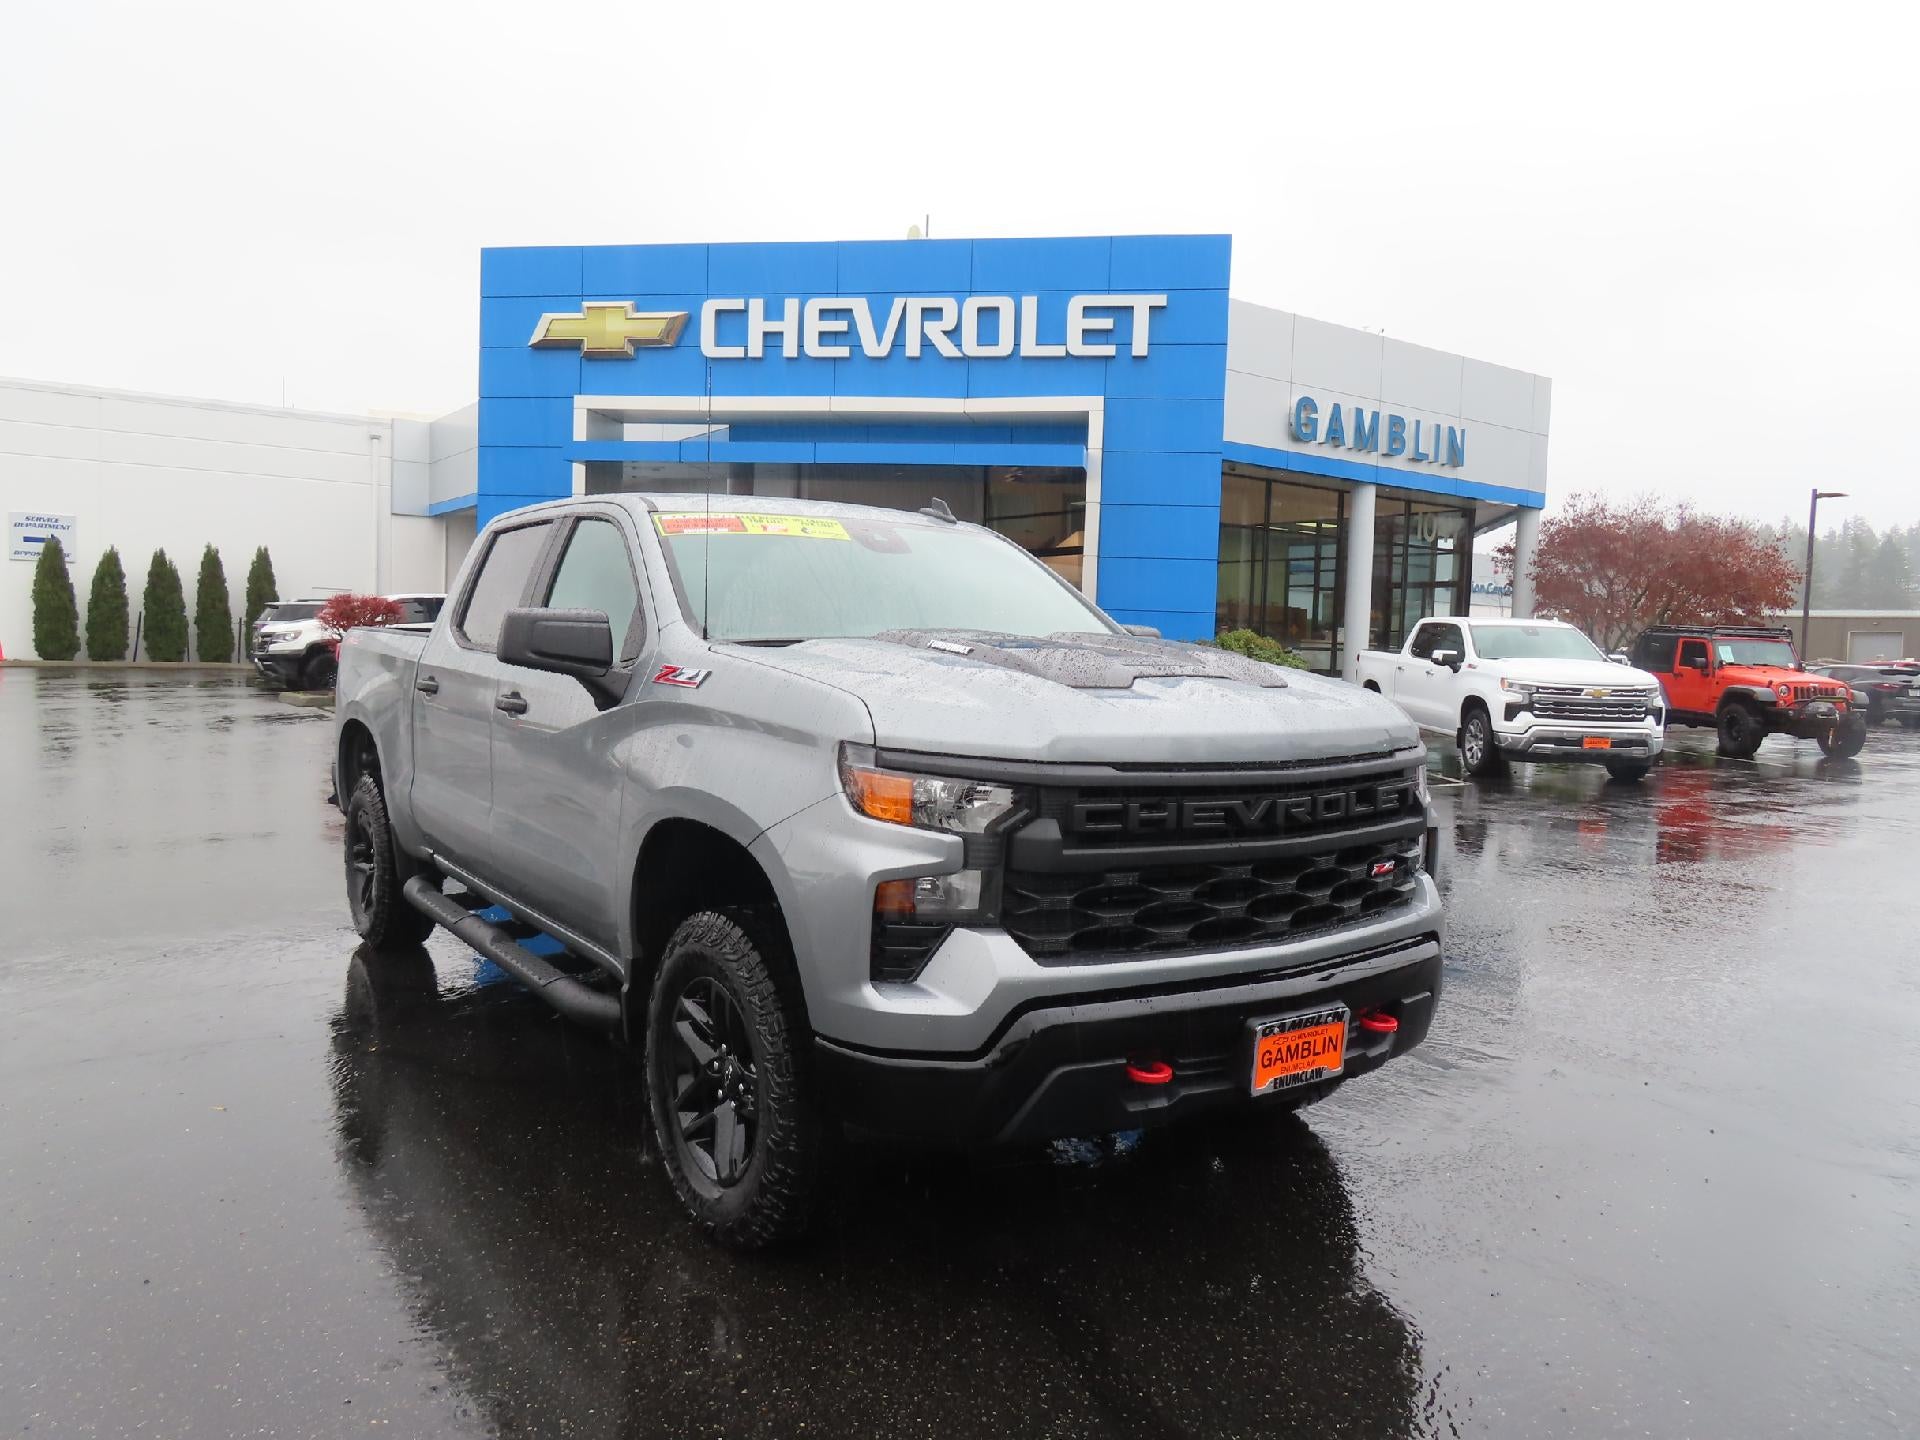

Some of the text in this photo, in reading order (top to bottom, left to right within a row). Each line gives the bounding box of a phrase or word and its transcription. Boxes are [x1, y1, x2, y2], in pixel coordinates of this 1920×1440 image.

[700, 294, 1167, 359] CHEVROLET
[1290, 396, 1466, 468] GAMBLIN
[13, 522, 71, 530] DEPARTMENT
[25, 515, 60, 523] SERVICE
[1073, 783, 1418, 830] CHEVROLET
[1290, 1028, 1328, 1042] CHEVROLET
[1261, 1034, 1339, 1069] GAMBLIN
[1273, 1066, 1327, 1090] ENUMCLAW
[1280, 1058, 1317, 1074] ENUMCLAW
